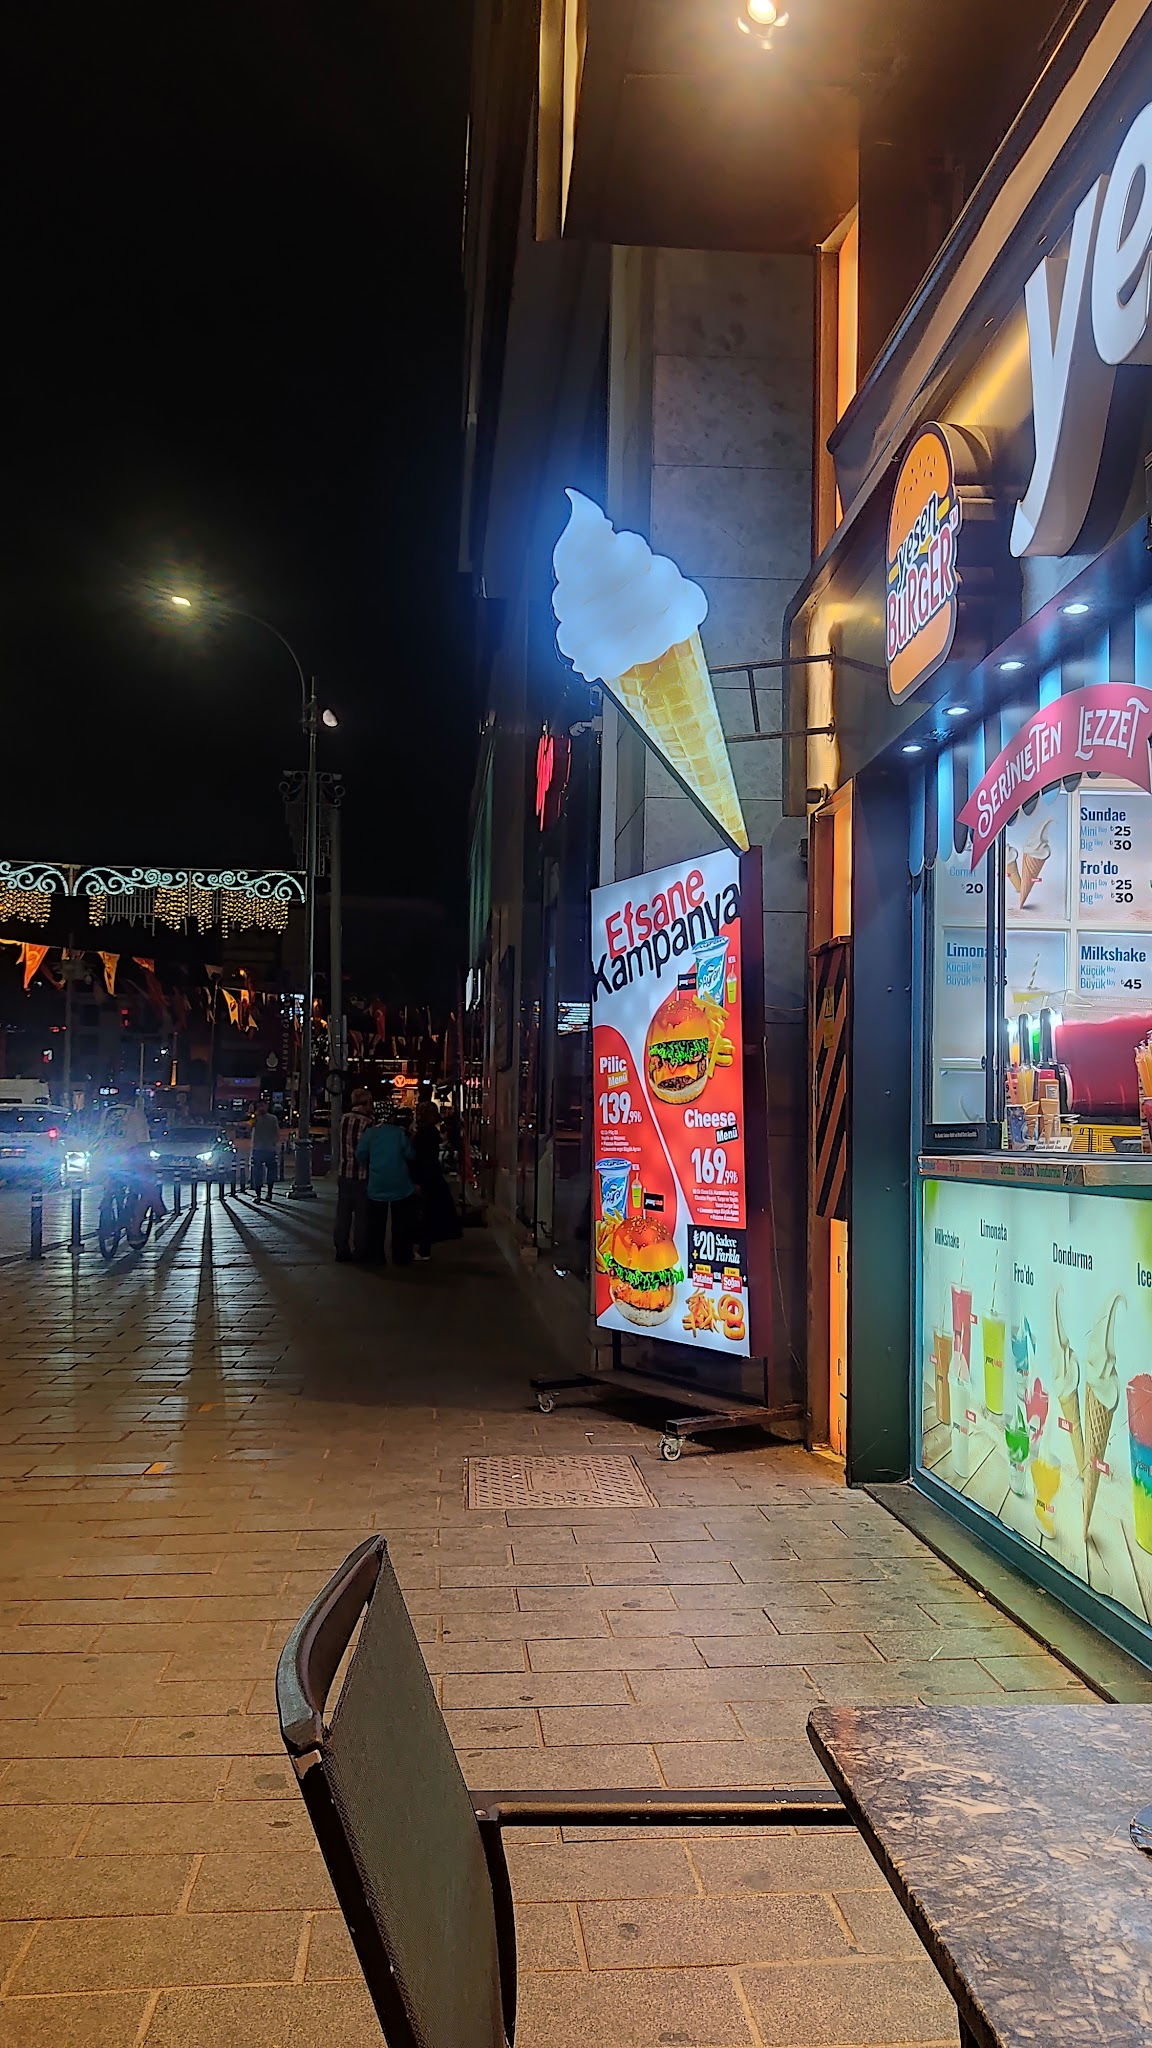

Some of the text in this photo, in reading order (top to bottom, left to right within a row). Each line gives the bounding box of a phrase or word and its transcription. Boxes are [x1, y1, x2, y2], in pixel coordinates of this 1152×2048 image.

[897, 491, 939, 592] yesen
[887, 524, 953, 661] BURGER
[1075, 697, 1150, 761] LEZZET
[1080, 807, 1126, 821] Sundae
[1080, 826, 1097, 836] Mini
[1080, 840, 1093, 851] Big
[1080, 861, 1118, 875] Fro'do
[1080, 880, 1097, 890] Mini
[1080, 893, 1093, 904] Big
[605, 869, 704, 959] Efsane
[591, 883, 740, 1002] Kampanya
[1081, 946, 1146, 962] Milkshake
[1080, 965, 1106, 978] Küçük
[1080, 978, 1106, 990] Büyük
[684, 1109, 737, 1129] Cheese
[716, 1127, 738, 1143] Menü
[934, 1227, 960, 1249] Milkshake
[980, 1219, 1008, 1241] Limonata
[716, 1247, 740, 1264] Farkla
[1052, 1242, 1093, 1271] Dondurma
[1013, 1263, 1034, 1286] Fro'do
[1137, 1262, 1152, 1288] Ice
